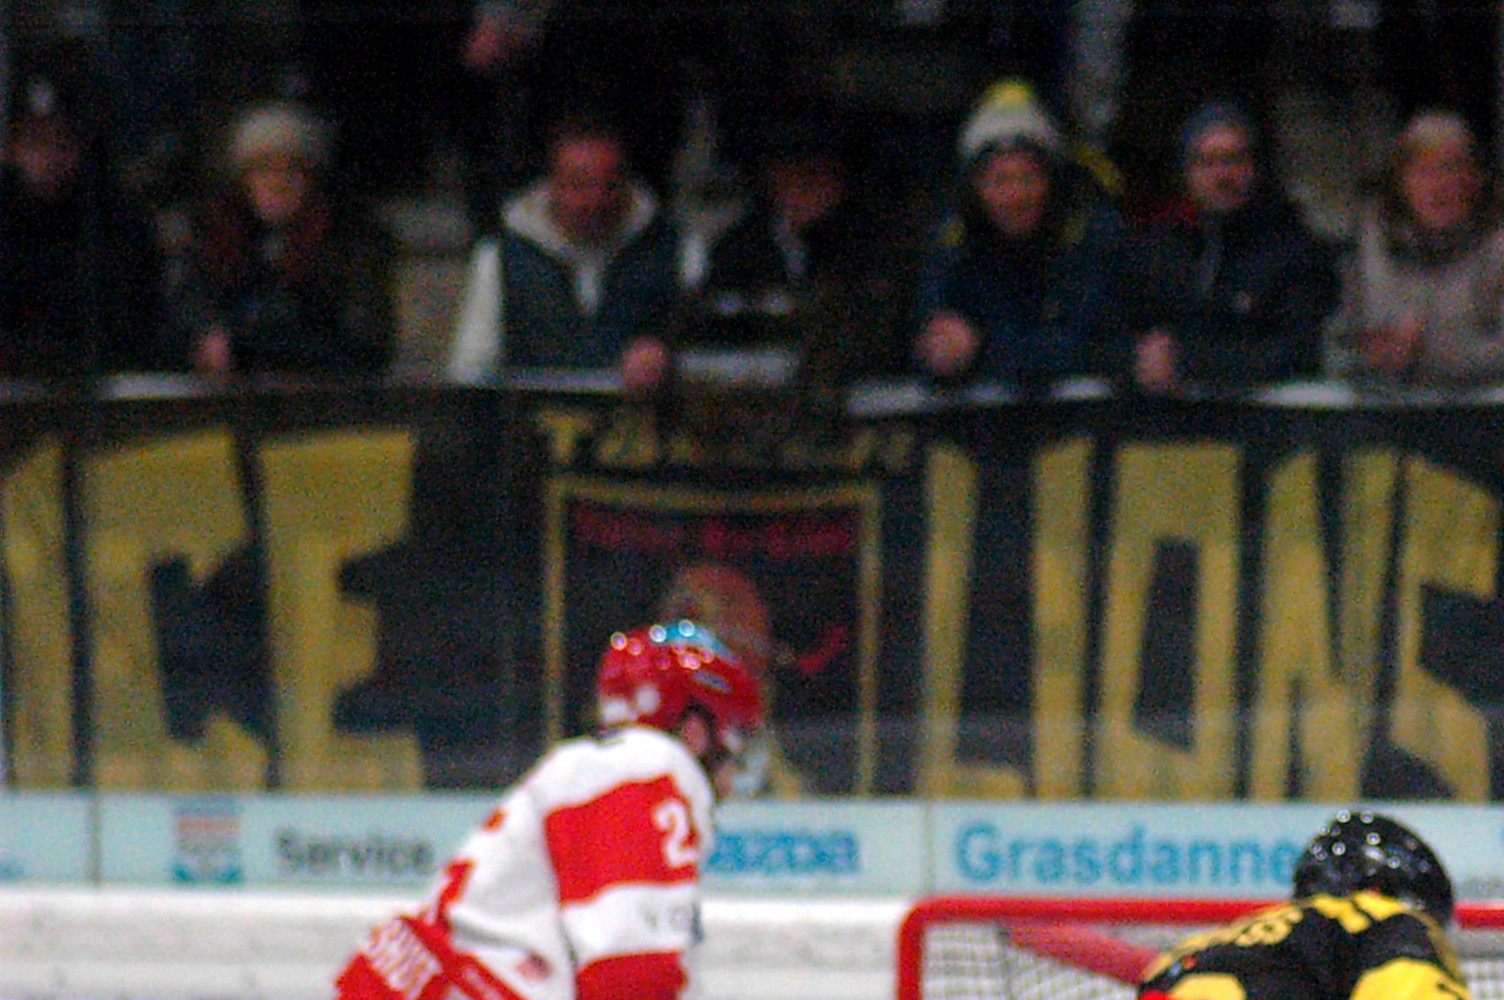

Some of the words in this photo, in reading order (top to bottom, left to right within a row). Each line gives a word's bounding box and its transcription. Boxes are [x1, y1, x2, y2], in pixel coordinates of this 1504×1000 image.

[912, 434, 1499, 800] LIONS
[702, 828, 861, 874] azda
[955, 818, 1296, 886] Grasdanne
